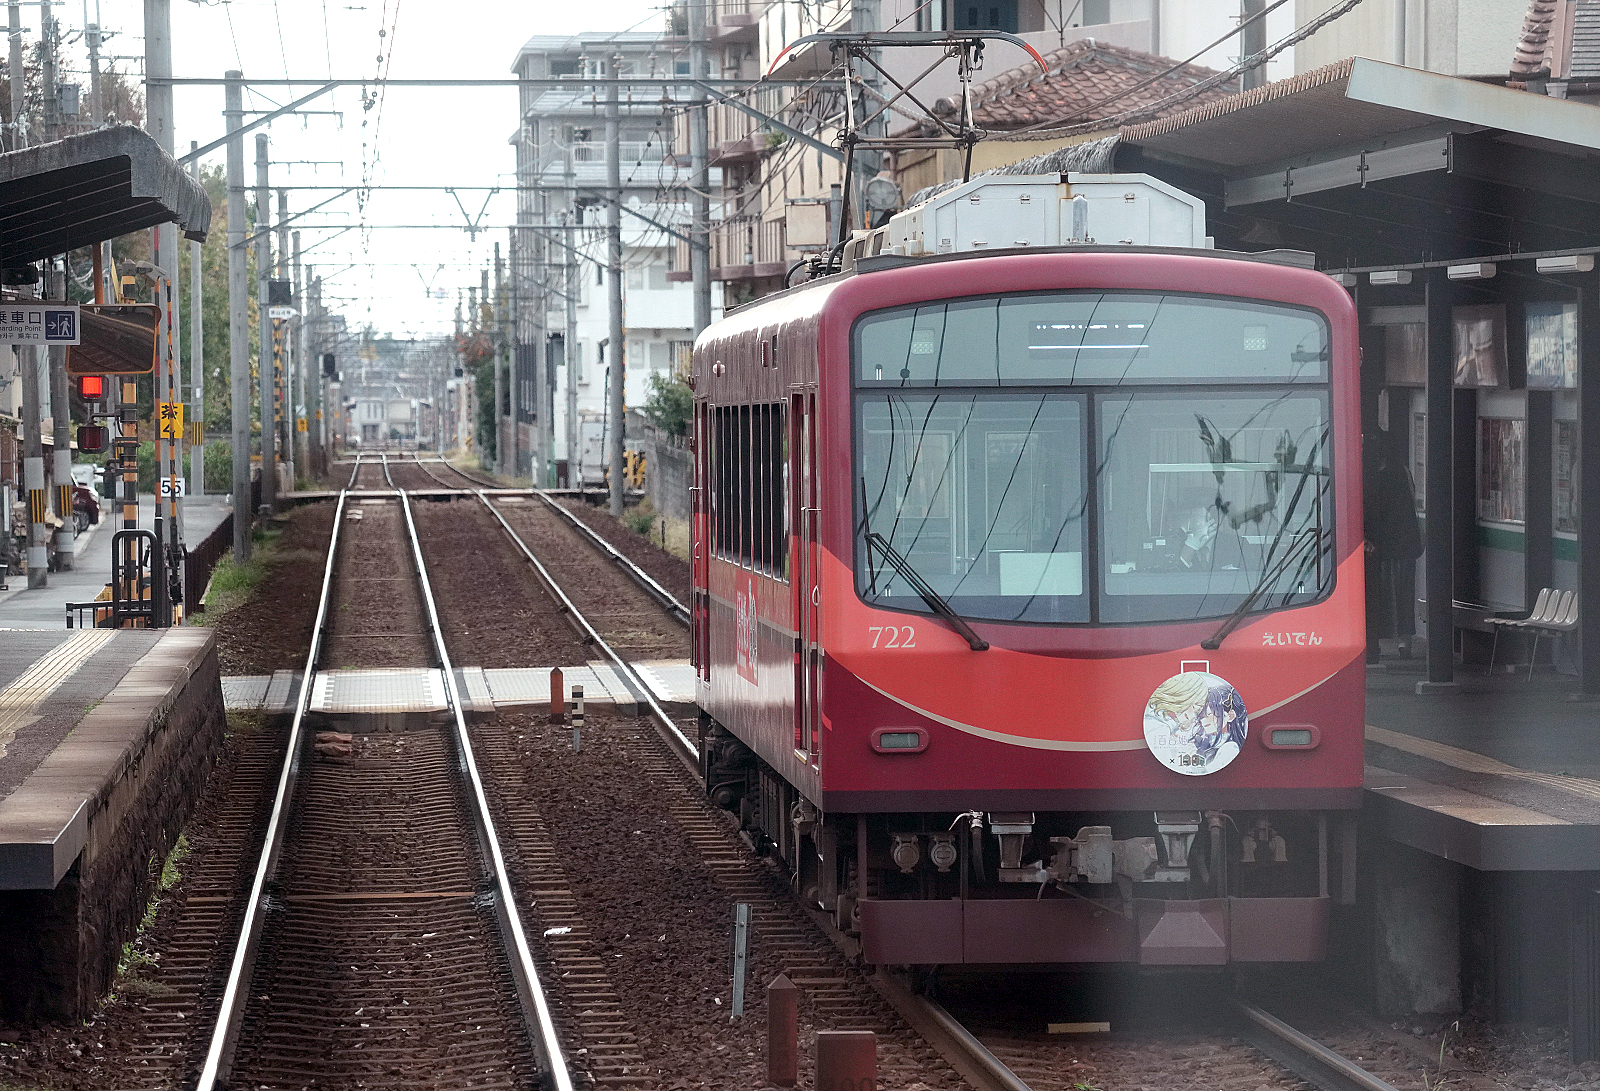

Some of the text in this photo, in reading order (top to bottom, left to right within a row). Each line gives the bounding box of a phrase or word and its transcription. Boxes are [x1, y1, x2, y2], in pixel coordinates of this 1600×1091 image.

[868, 626, 916, 648] 722
[1262, 632, 1323, 645] えいでん
